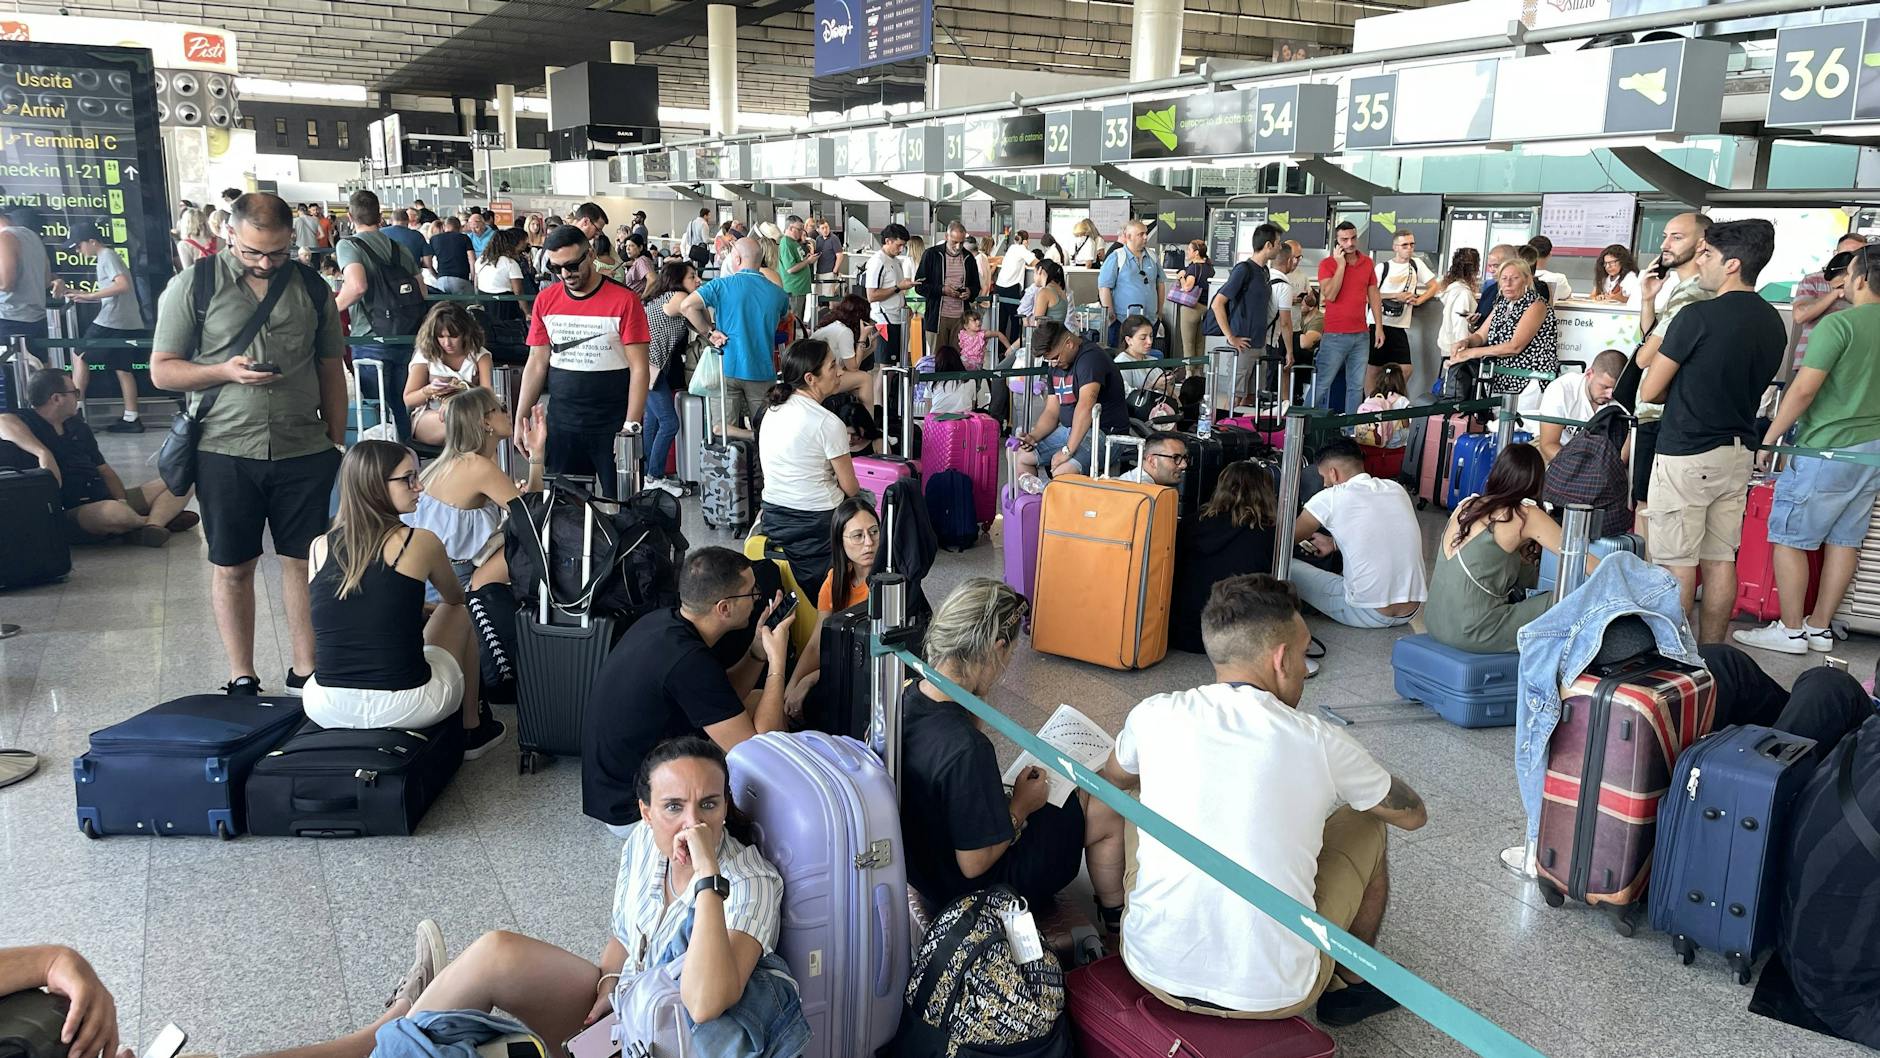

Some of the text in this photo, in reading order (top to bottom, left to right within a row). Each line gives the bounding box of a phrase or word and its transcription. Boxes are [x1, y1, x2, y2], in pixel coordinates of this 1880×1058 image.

[187, 36, 225, 58] Pisti
[16, 71, 73, 89] Uscita
[1779, 47, 1850, 101] 36
[20, 102, 66, 118] Arrivi
[1259, 101, 1293, 138] 34
[1351, 92, 1389, 132] 35
[21, 132, 117, 150] Terminal C
[1047, 124, 1069, 153] 32
[1104, 117, 1129, 149] 33
[835, 144, 848, 167] 29
[908, 138, 923, 161] 30
[947, 134, 962, 159] 31
[65, 163, 101, 179] 1-21
[0, 192, 107, 211] ervizi igienici
[1574, 318, 1594, 328] Desk
